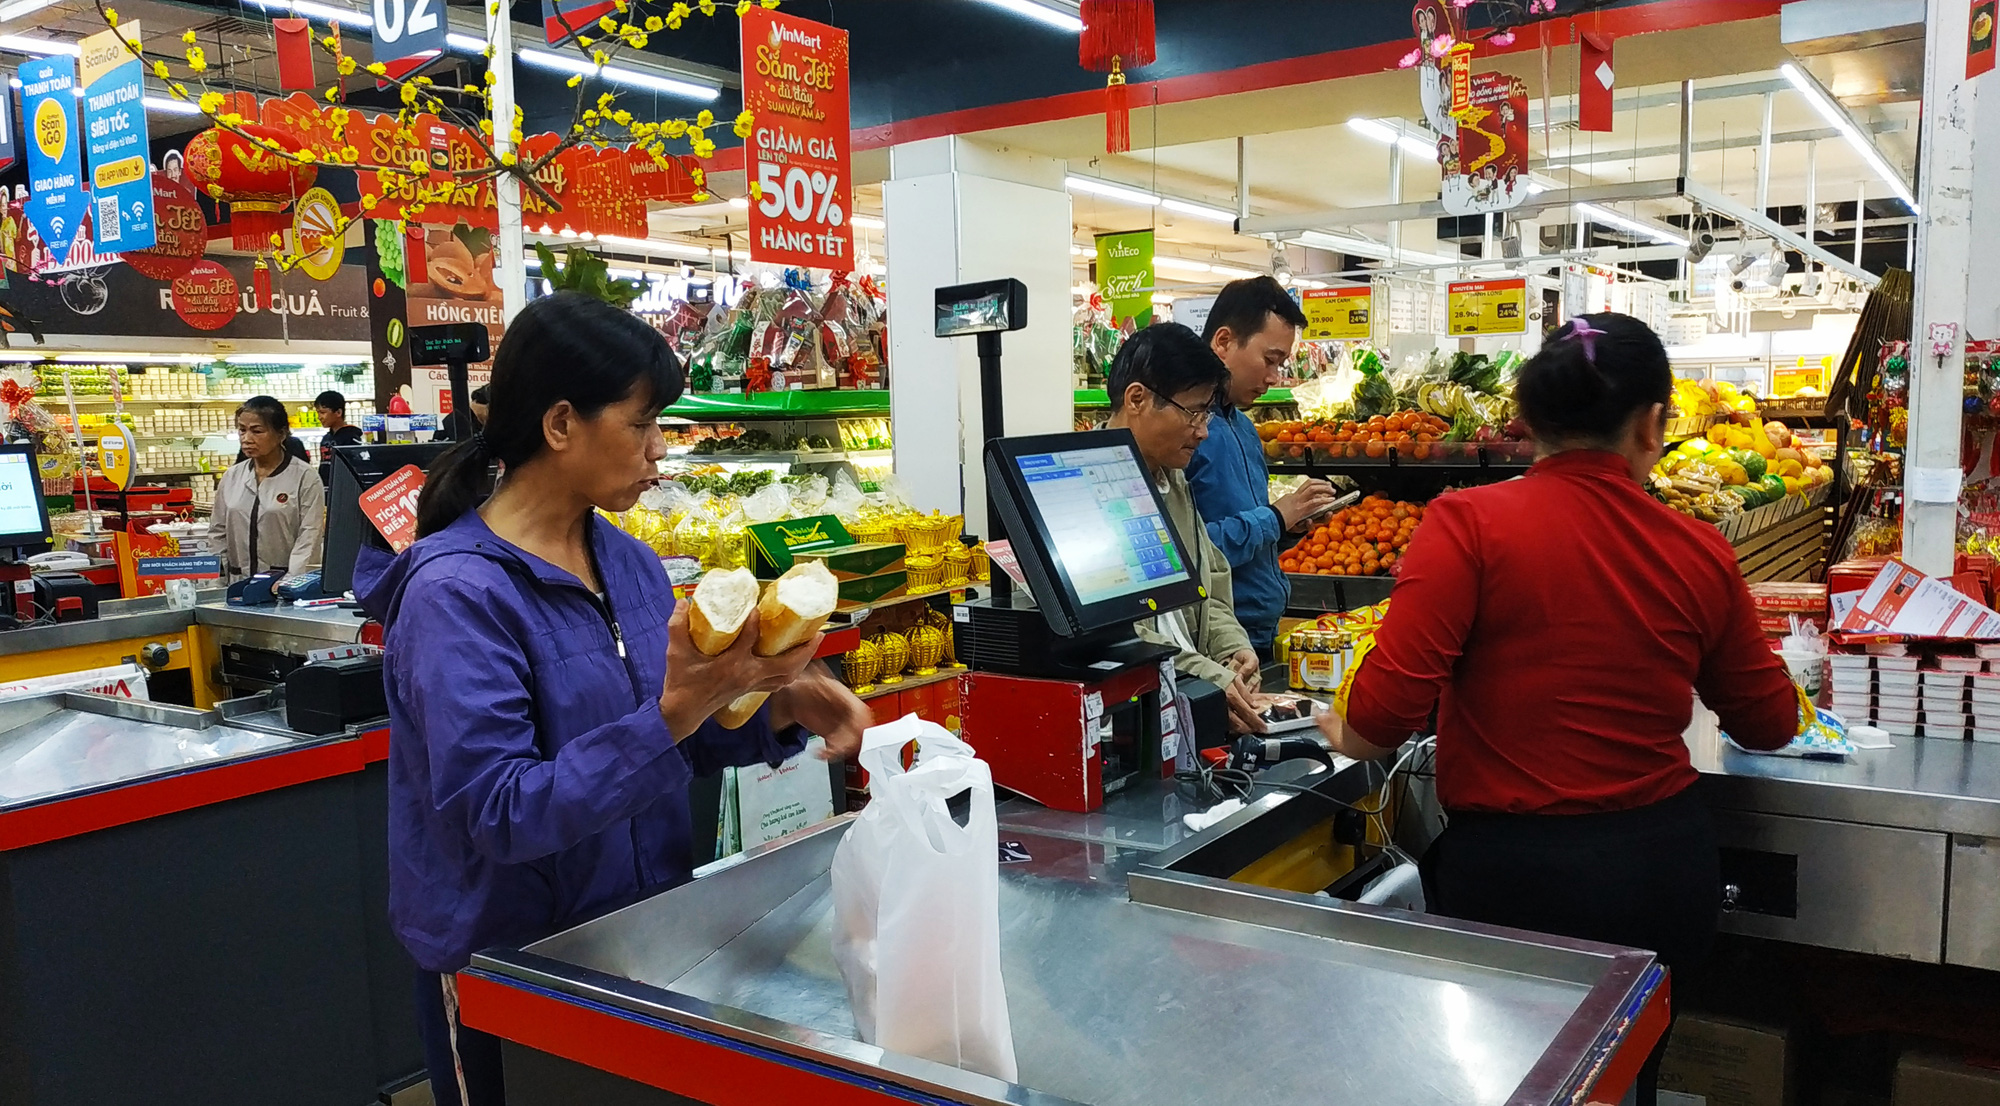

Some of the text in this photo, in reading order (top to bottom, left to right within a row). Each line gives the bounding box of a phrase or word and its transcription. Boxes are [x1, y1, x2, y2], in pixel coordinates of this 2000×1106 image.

[770, 20, 821, 49] VinMart
[756, 45, 834, 90] Sắm Tết
[24, 74, 71, 97] THANH TOÁN
[1473, 75, 1496, 86] VinMart
[88, 82, 139, 112] THANH TOÁN
[778, 83, 815, 106] đủ đầy
[768, 100, 784, 112] SUM
[815, 108, 826, 121] ÁP
[41, 119, 60, 132] Scan
[91, 108, 130, 138] SIÊU TỐC
[756, 127, 838, 162] GIẢM GIÁ
[758, 149, 772, 162] LÊN
[34, 173, 74, 192] GIAO HÀNG
[106, 168, 116, 180] APP
[758, 162, 844, 227] 50%
[166, 204, 202, 232] Tết
[158, 230, 180, 246] đầy
[761, 227, 846, 256] HÀNG TẾT
[1108, 246, 1140, 258] VinEco
[190, 268, 217, 276] VinMart
[176, 277, 235, 295] Sắm Tết
[270, 290, 324, 317] QUẢ
[331, 304, 358, 318] Fruit
[360, 306, 370, 318] &
[426, 302, 472, 322] HỒNG
[428, 370, 448, 380] Các
[366, 470, 413, 502] THANH TOÁN BẰNG
[382, 484, 408, 502] VINID PAY
[375, 504, 400, 522] TÍCH
[383, 514, 409, 536] ĐIỂM
